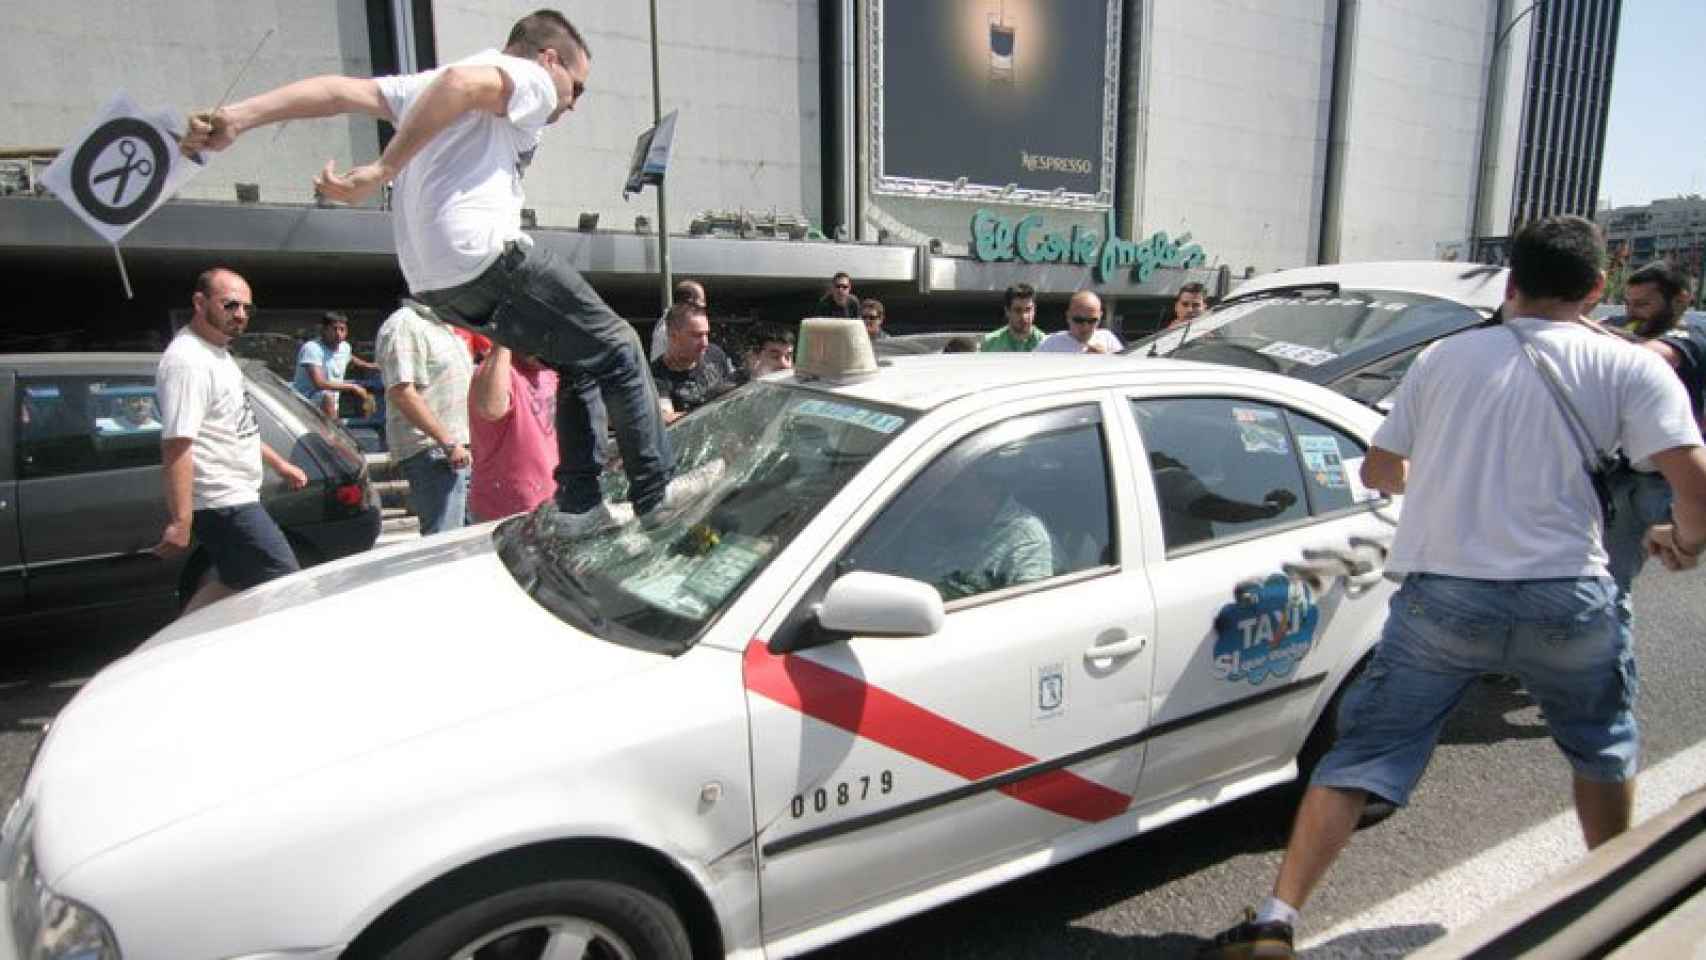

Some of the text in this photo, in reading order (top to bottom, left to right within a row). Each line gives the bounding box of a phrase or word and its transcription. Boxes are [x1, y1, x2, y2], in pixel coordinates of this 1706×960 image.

[1021, 151, 1092, 174] NESPRESSO
[971, 206, 1207, 284] El Corte Inglés
[791, 769, 893, 819] 00879
